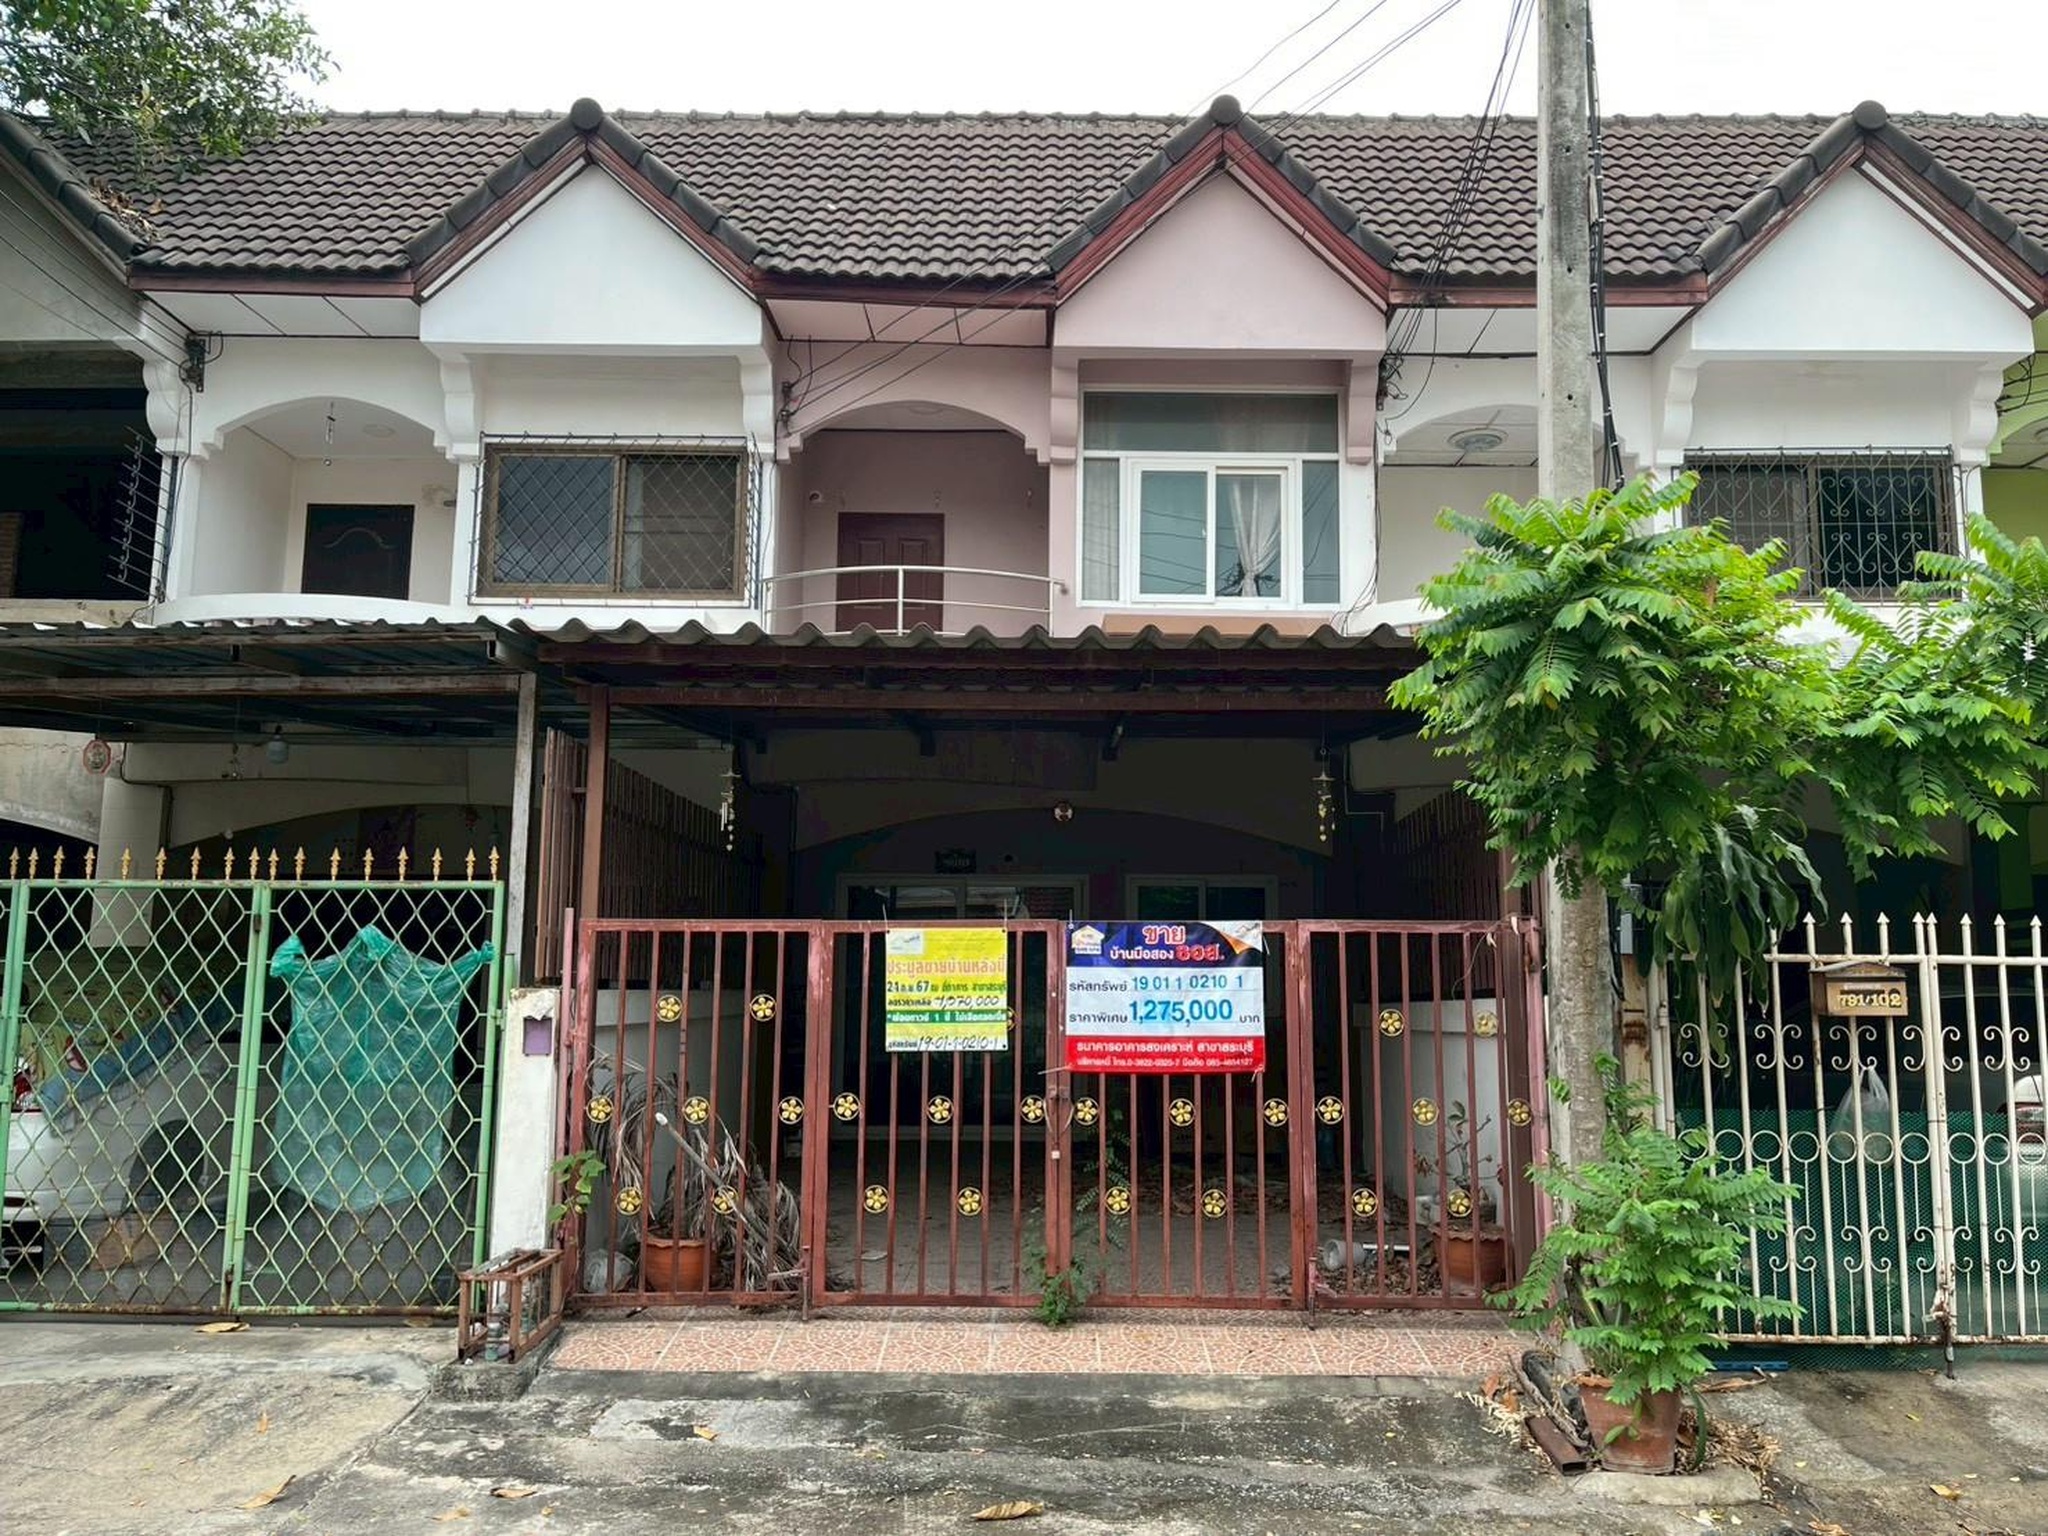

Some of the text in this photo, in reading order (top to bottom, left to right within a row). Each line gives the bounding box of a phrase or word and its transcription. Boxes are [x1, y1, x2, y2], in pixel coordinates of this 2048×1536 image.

[1142, 923, 1187, 945] ขาย
[1109, 945, 1174, 960] บ้านมือสอง
[916, 980, 930, 992] 67
[1068, 974, 1244, 993] รหัสทรัพย์ 19 01 1 0210 1
[1838, 992, 1902, 1008] 791/102
[1068, 998, 1261, 1027] ราคาพิเศษ 1,275,000 บาท
